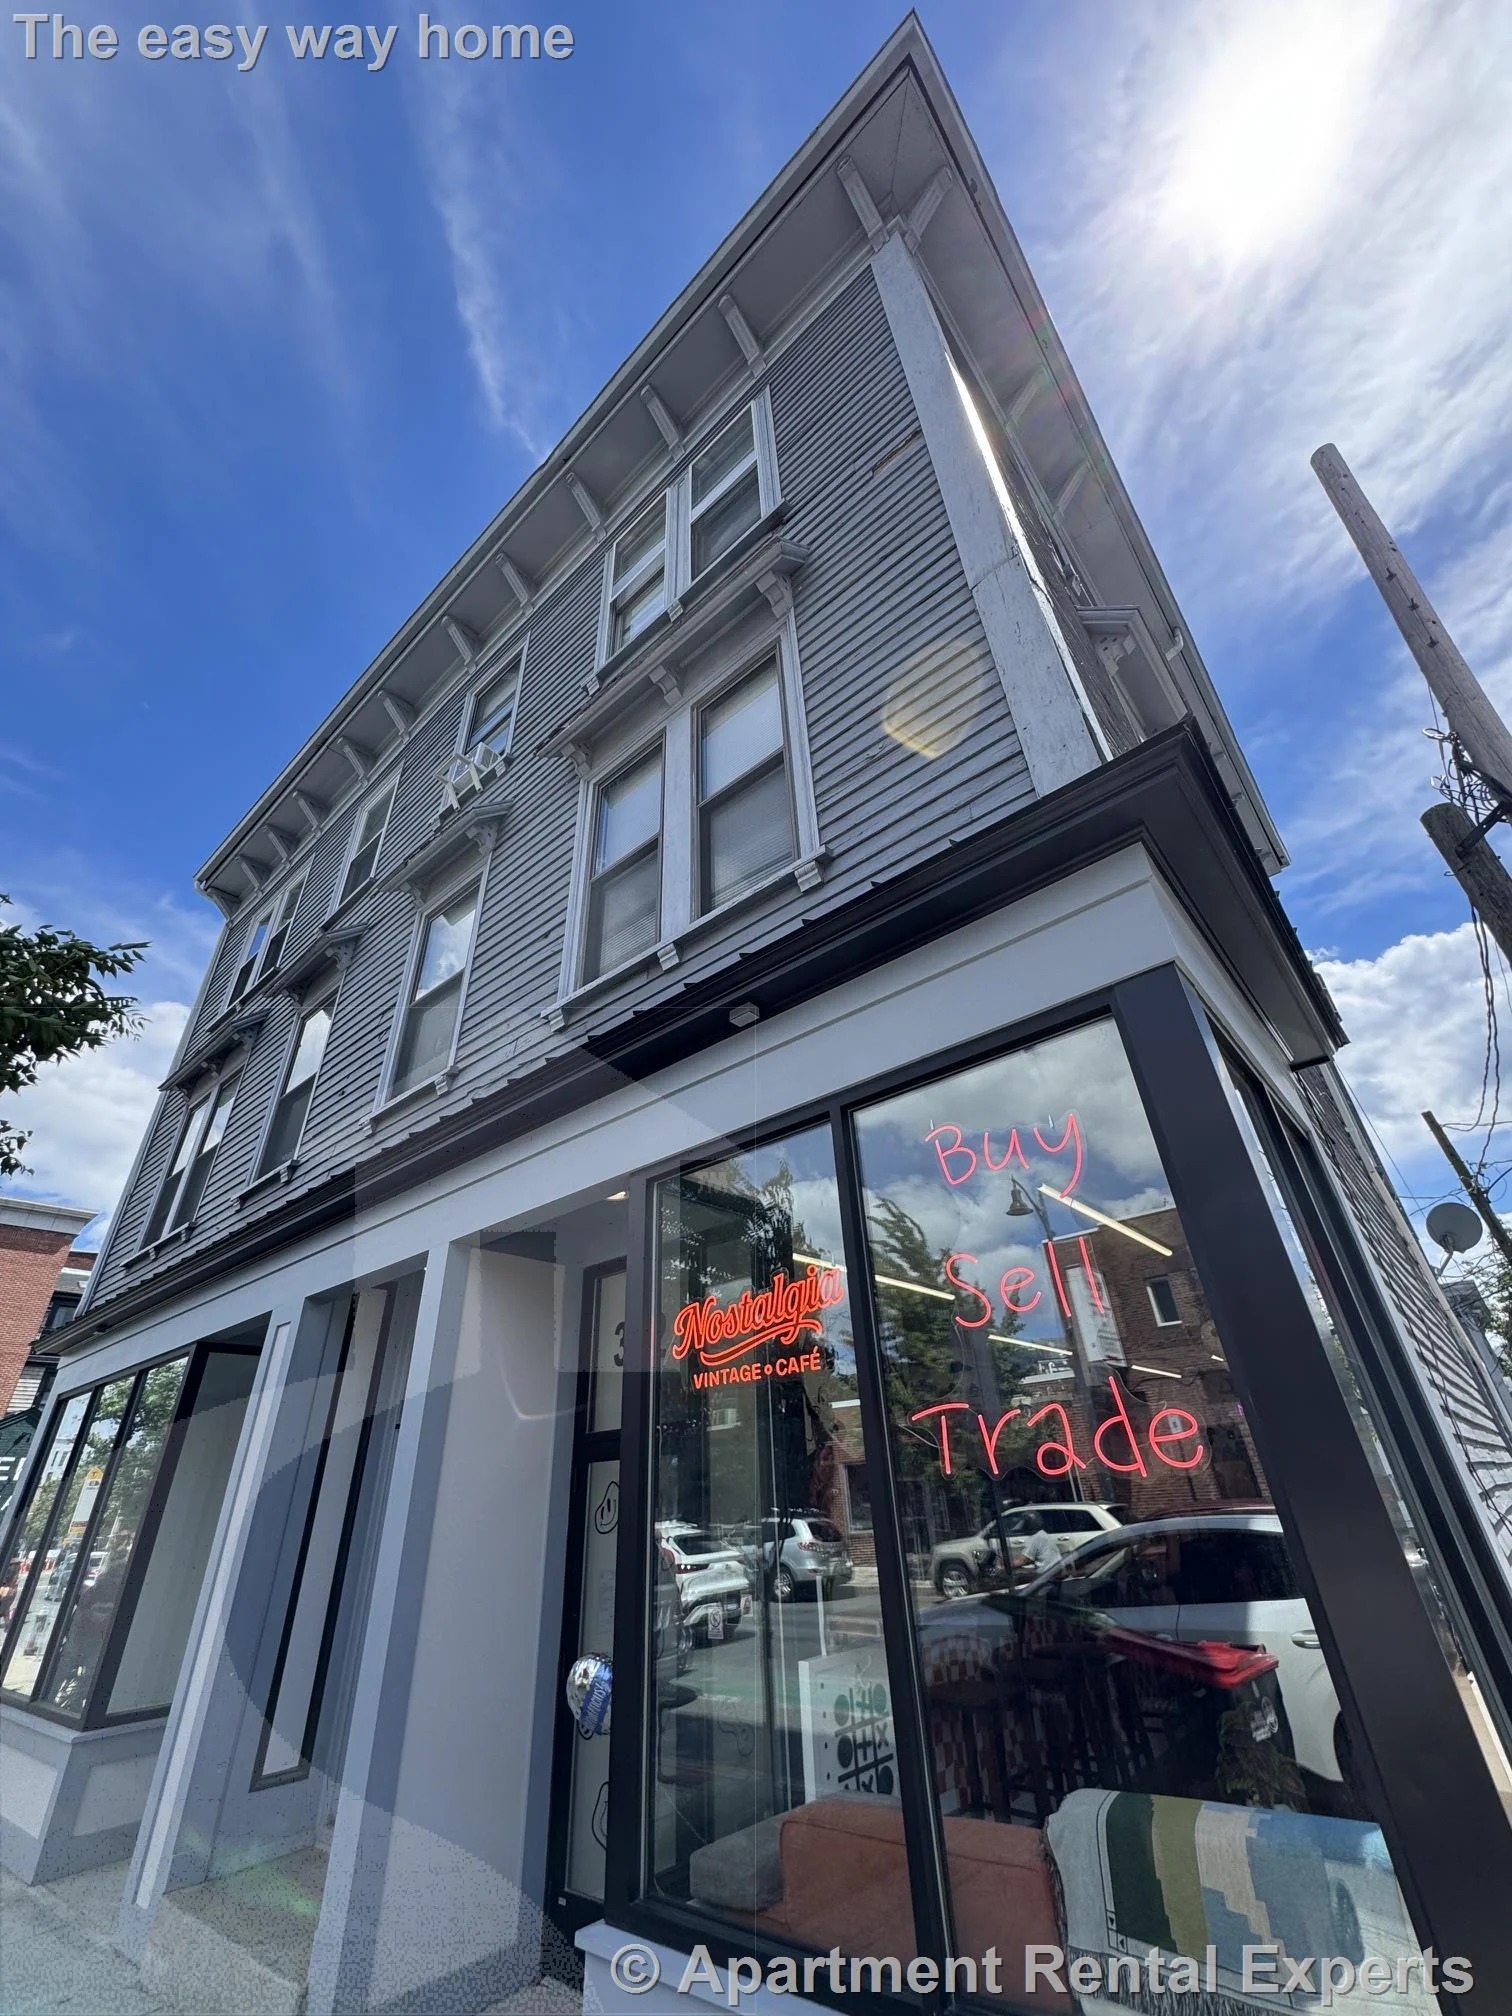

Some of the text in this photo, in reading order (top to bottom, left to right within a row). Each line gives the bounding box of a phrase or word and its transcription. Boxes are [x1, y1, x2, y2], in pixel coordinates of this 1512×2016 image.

[925, 1113, 1084, 1200] Buy
[672, 1264, 844, 1361] Nostalgia
[945, 1236, 1105, 1328] Sell
[693, 1346, 822, 1390] VINTAGE CAFÉ
[911, 1376, 1204, 1478] Trade
